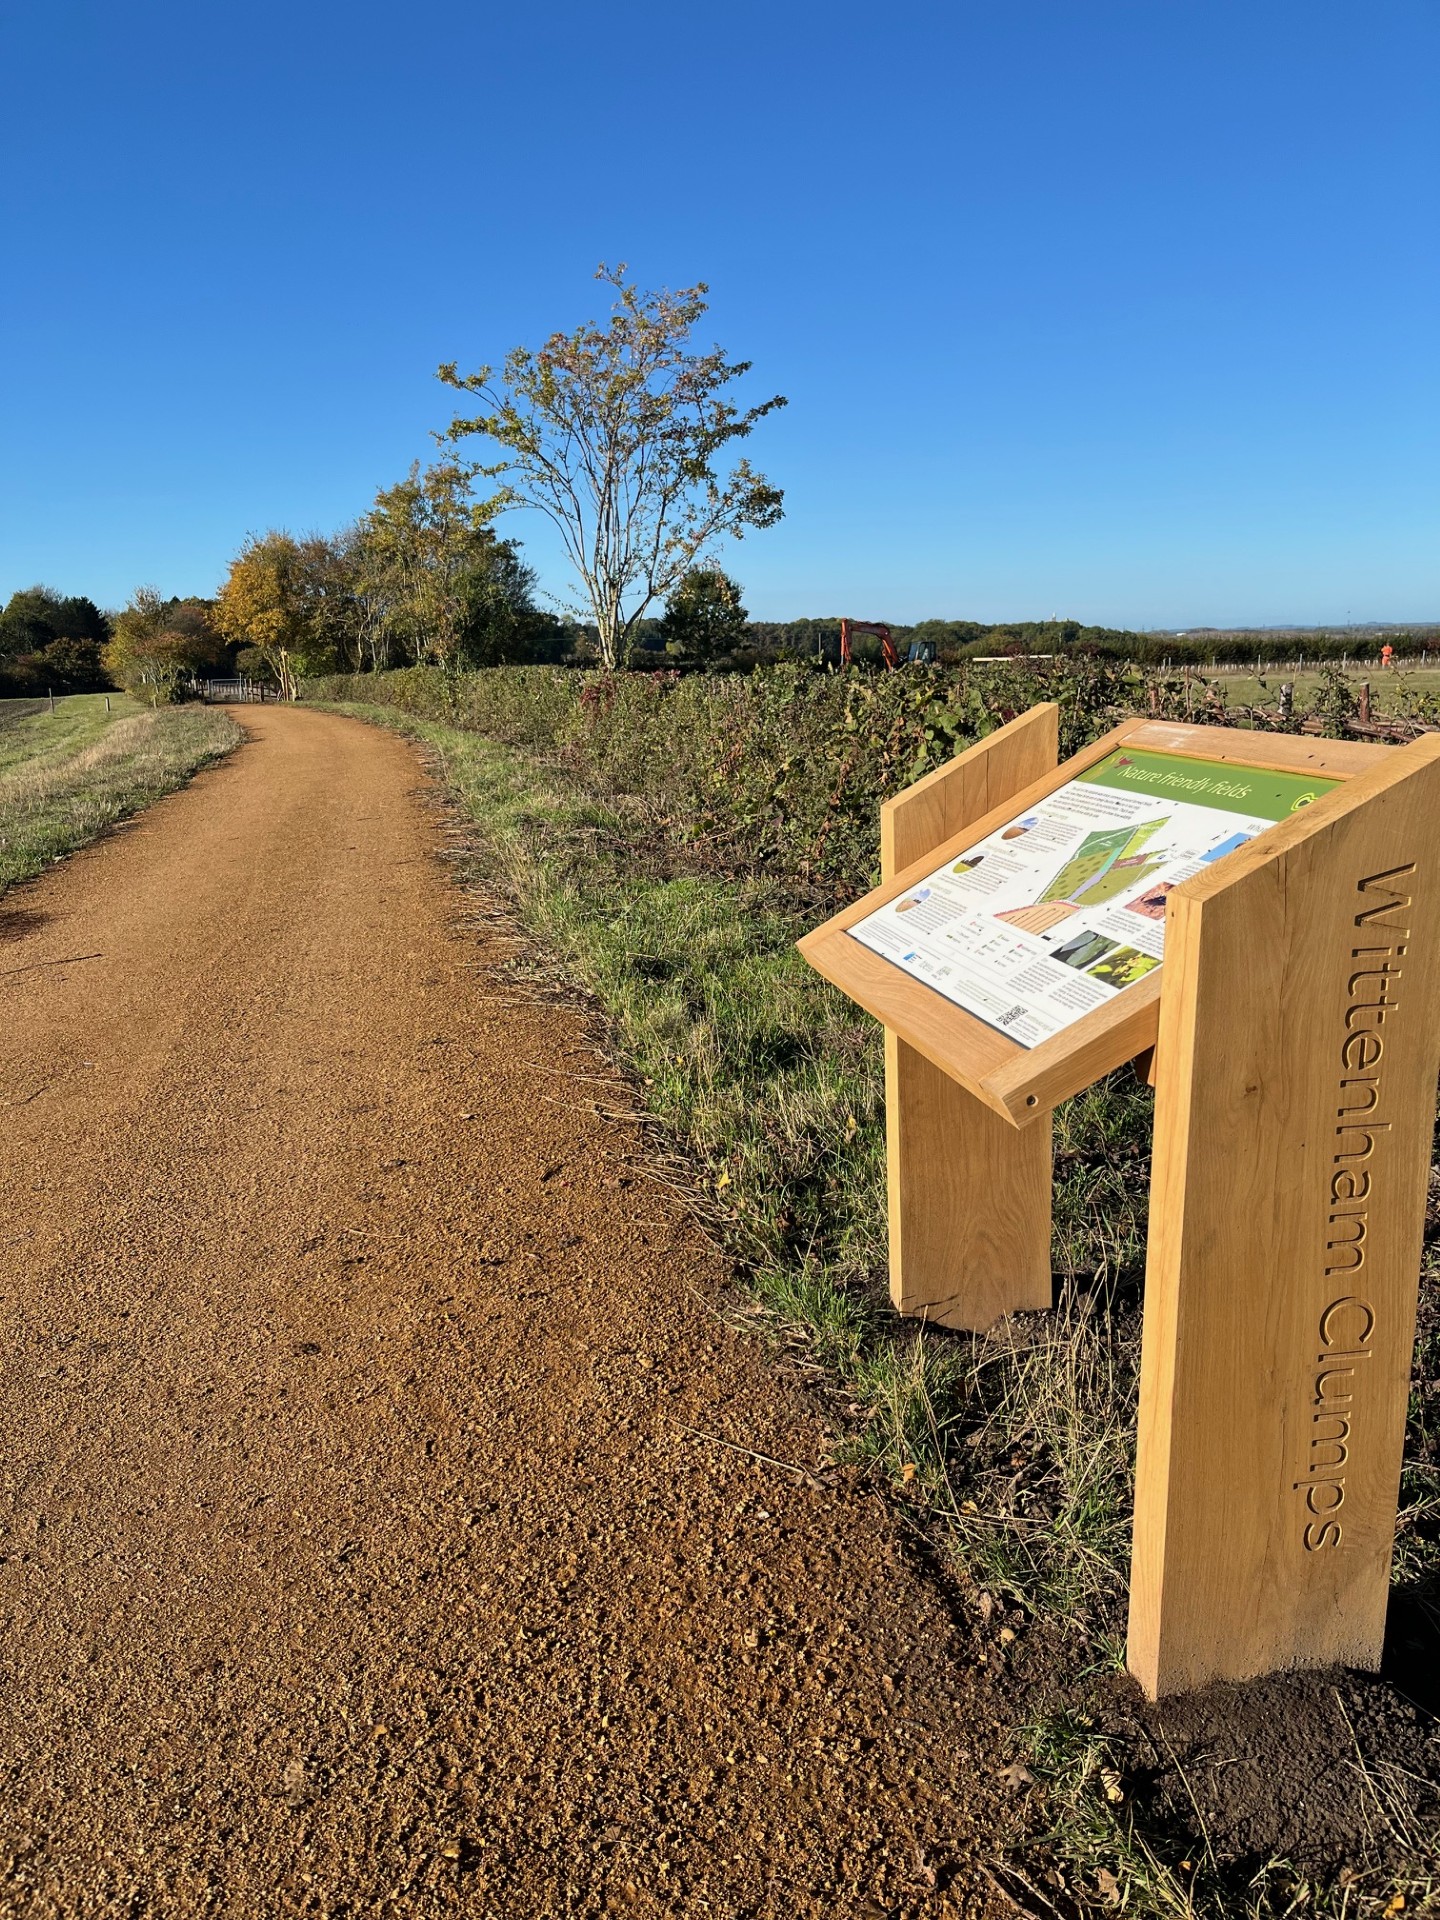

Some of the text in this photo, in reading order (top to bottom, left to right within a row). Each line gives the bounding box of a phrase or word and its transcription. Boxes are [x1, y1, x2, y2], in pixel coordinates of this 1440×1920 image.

[1117, 766, 1252, 798] Nature friendly fields
[1292, 861, 1417, 1552] Wittenham Clumps
